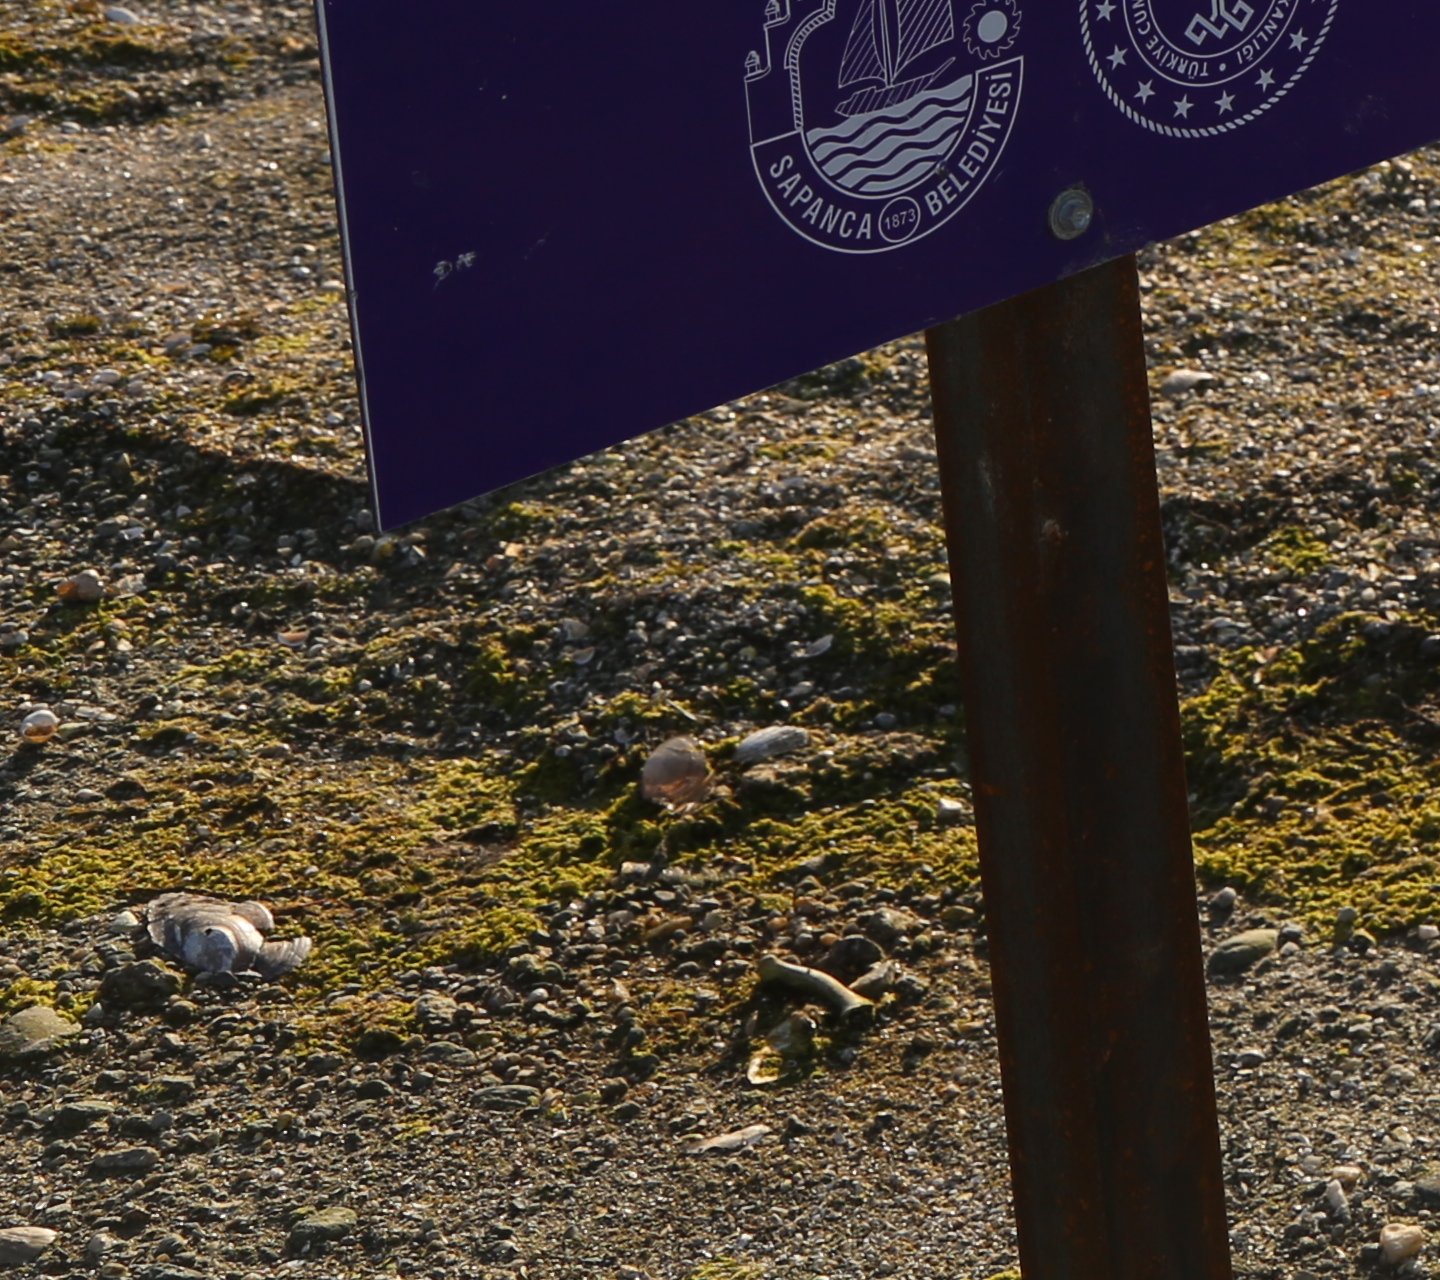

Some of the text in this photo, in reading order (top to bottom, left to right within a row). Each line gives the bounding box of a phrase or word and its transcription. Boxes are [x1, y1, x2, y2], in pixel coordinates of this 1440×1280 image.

[1146, 35, 1208, 79] TÜRKİYE
[770, 72, 1012, 239] SAPANCA BELEDİYESİ
[884, 208, 916, 230] 1873
